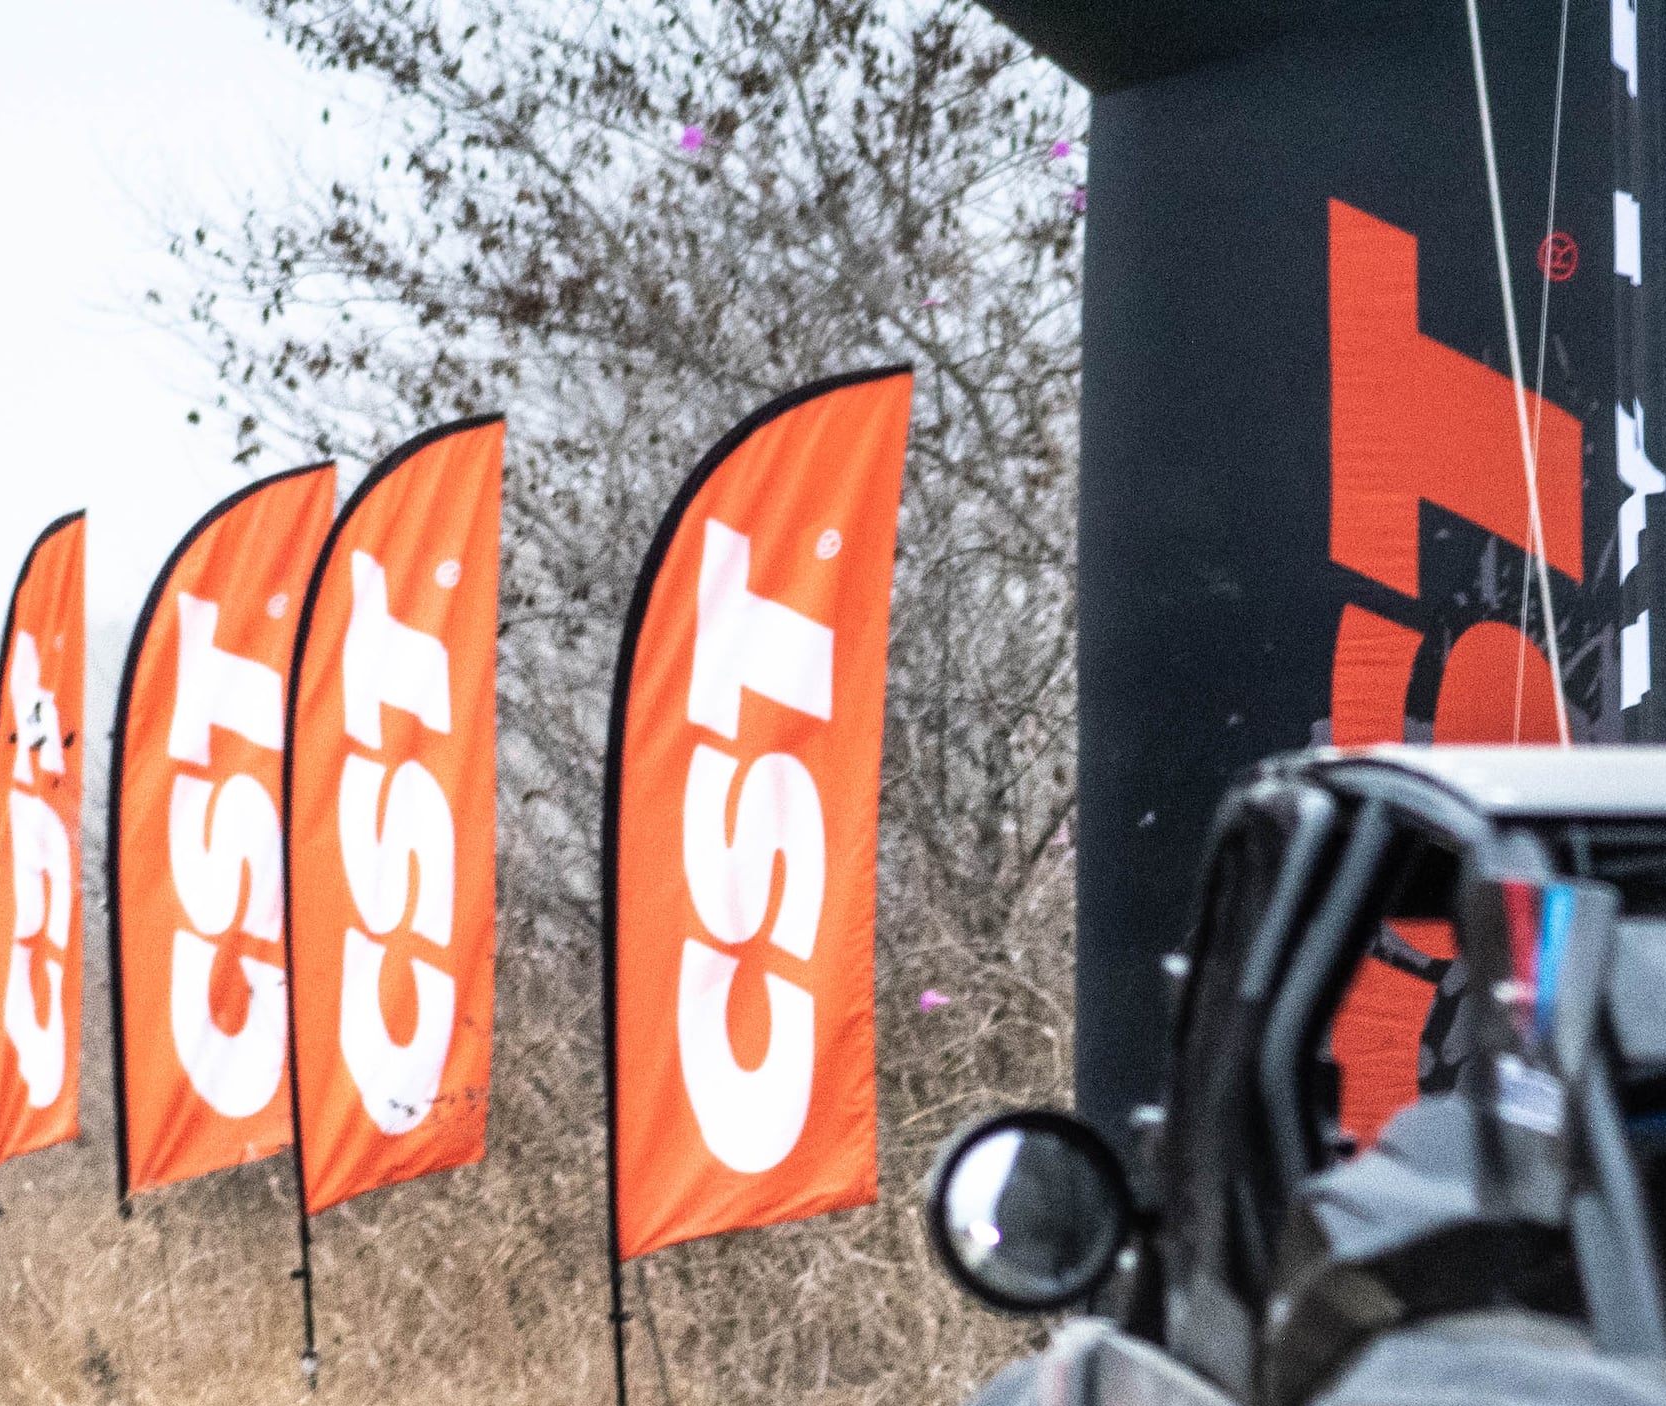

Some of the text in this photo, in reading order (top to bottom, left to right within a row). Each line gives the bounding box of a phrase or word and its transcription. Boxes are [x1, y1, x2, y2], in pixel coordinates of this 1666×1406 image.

[167, 590, 285, 1119] CST
[337, 548, 452, 1135] CST
[675, 518, 834, 1175] CST
